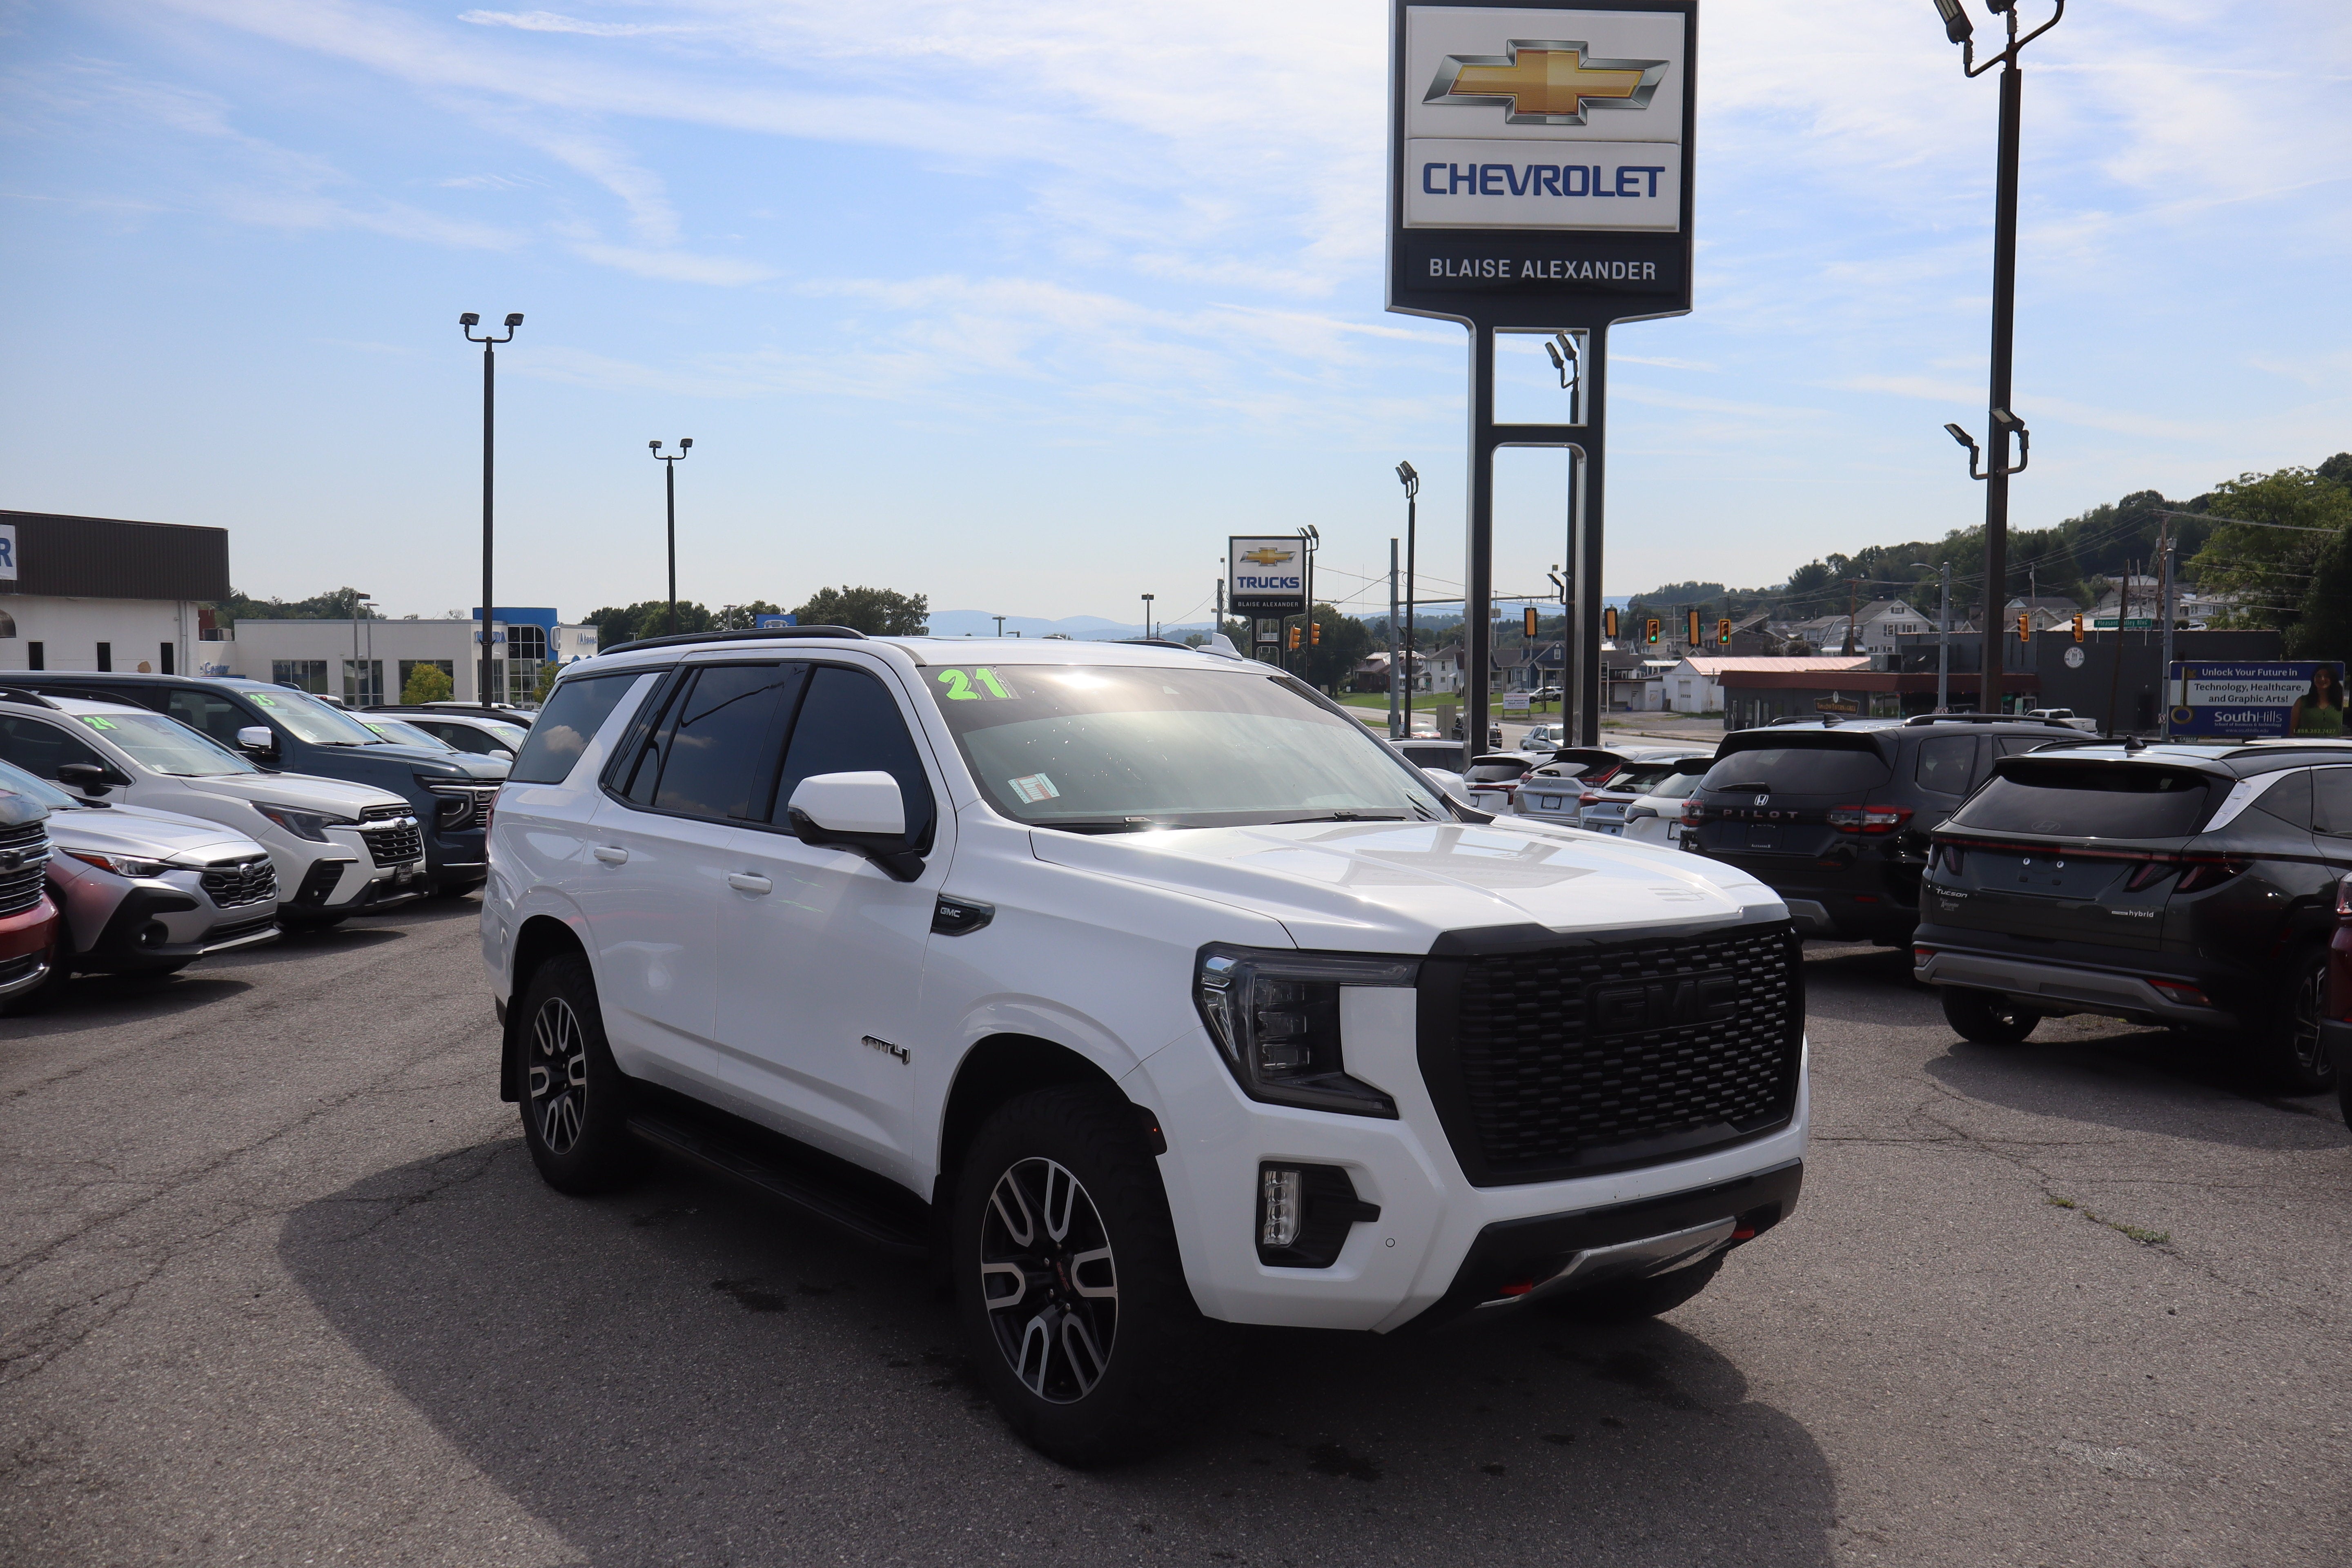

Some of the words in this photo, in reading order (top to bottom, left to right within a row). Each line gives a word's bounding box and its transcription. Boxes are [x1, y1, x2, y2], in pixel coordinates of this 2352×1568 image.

[1423, 163, 1666, 198] CHEVROLET
[1430, 258, 1511, 278] BLAISE
[1521, 260, 1656, 281] ALEXANDER
[1237, 576, 1299, 588] TRUCKS
[2202, 668, 2233, 676] Unlock
[2289, 668, 2298, 676] in
[937, 668, 1011, 701] 21
[2194, 683, 2249, 693] Technology,
[2251, 683, 2304, 692] Healthcare,
[249, 694, 276, 706] 25
[2209, 695, 2226, 703] and
[2228, 695, 2264, 704] Graphic
[2265, 695, 2288, 703] Arts!
[83, 717, 118, 730] 24
[364, 724, 386, 733] 23
[1723, 809, 1798, 818] PILOT
[940, 907, 961, 918] GMC
[1596, 974, 1737, 1029] GMC
[861, 1033, 911, 1065] AT4
[1056, 1261, 1071, 1292] GMC
